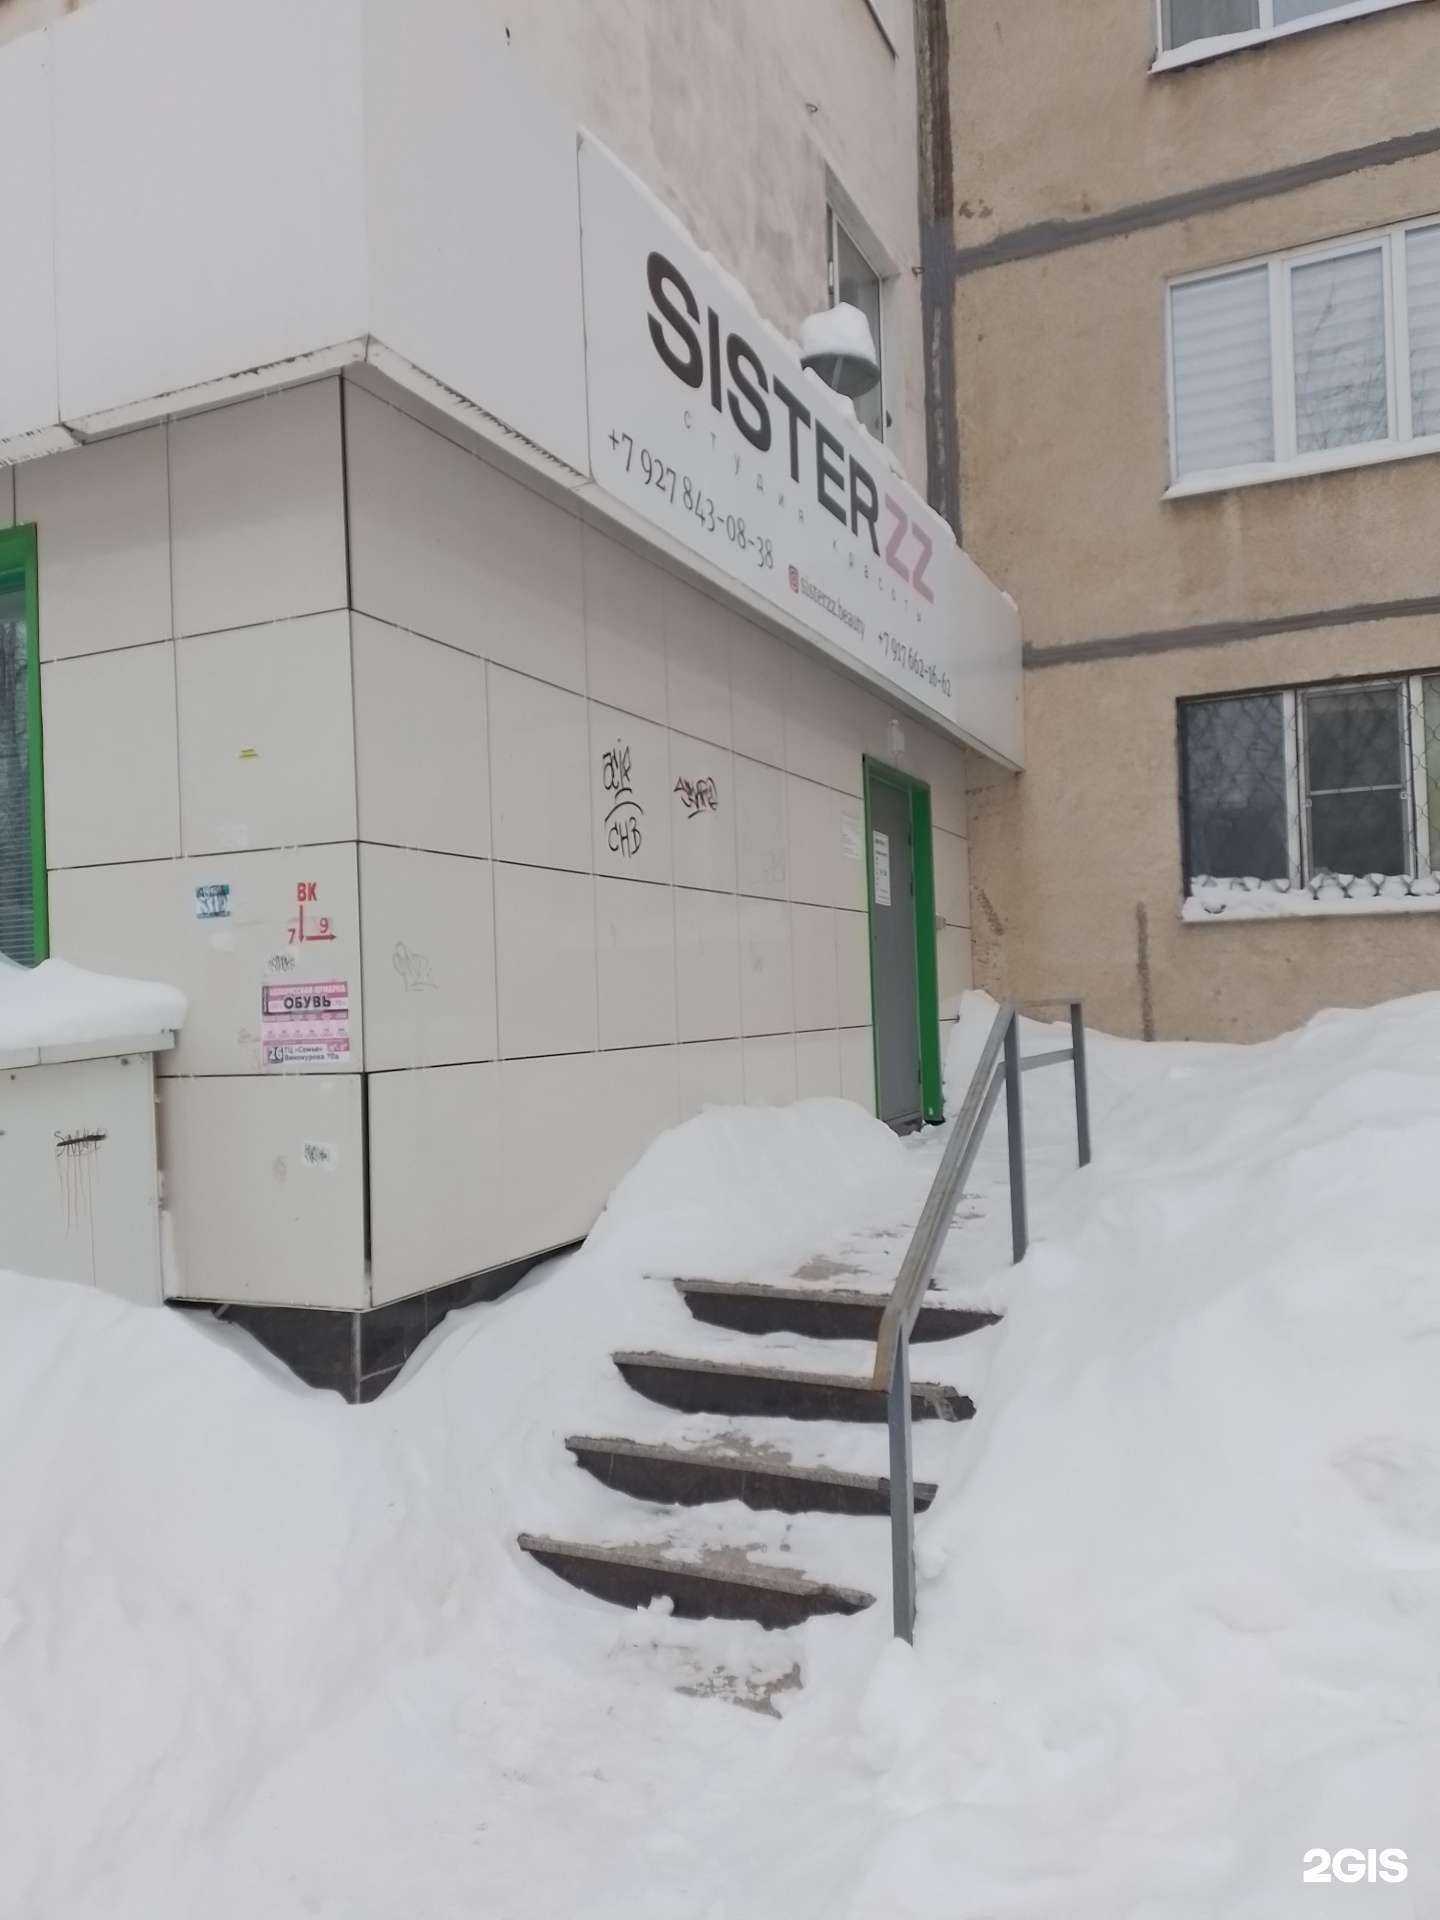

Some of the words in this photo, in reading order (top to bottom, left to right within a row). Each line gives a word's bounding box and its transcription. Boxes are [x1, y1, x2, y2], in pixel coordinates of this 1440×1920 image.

[646, 250, 935, 605] SISTERZZ
[608, 428, 634, 473] +7
[640, 448, 677, 504] 927
[682, 475, 774, 569] 843-08-38
[297, 882, 317, 901] ВК
[319, 917, 329, 934] 9
[288, 928, 296, 944] 7
[283, 995, 332, 1009] ОБУВЬ
